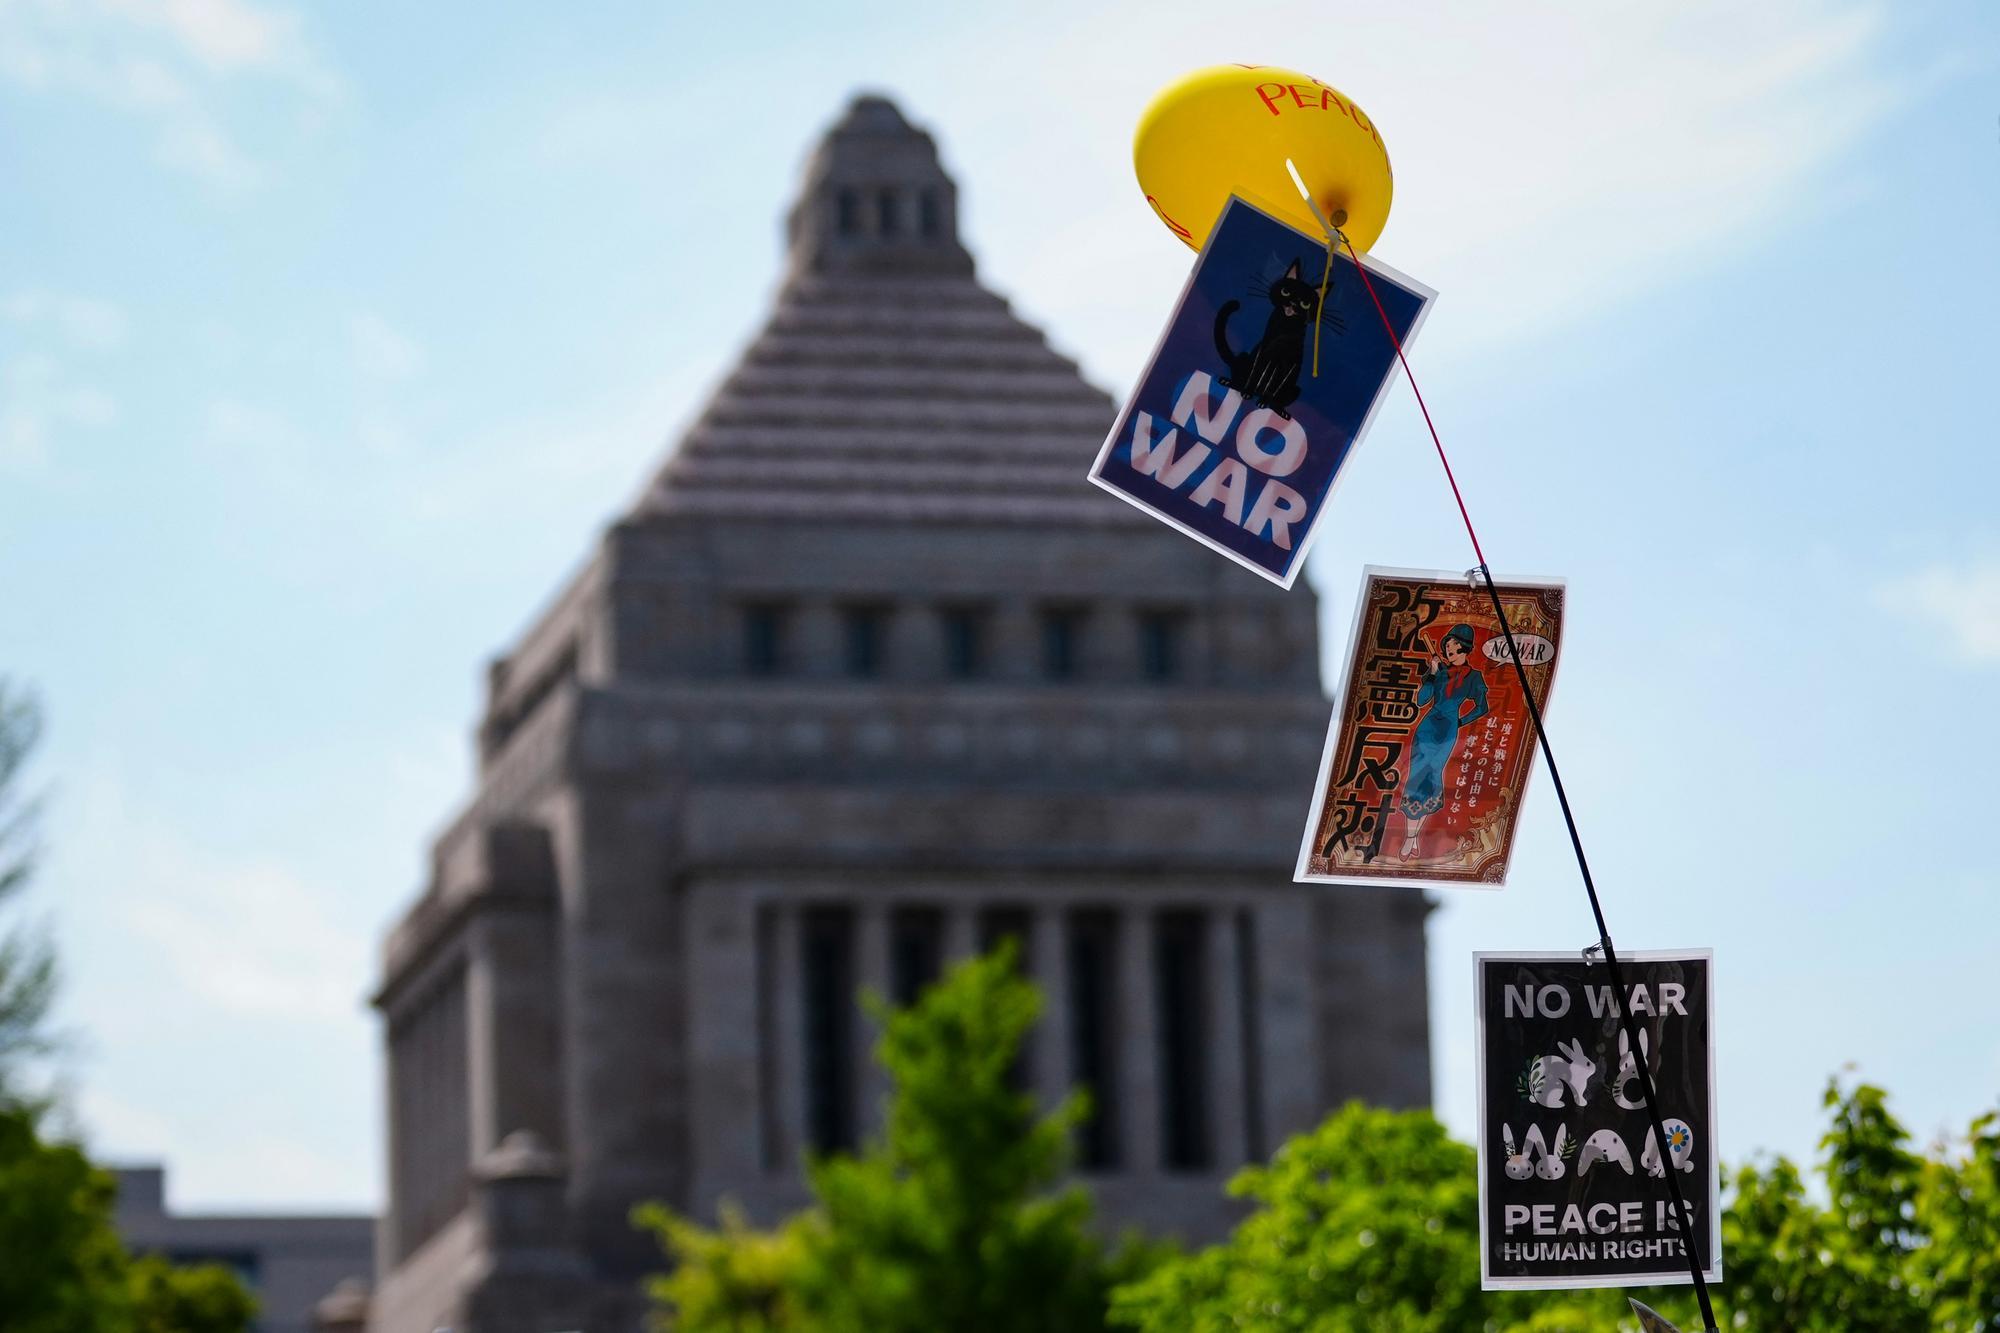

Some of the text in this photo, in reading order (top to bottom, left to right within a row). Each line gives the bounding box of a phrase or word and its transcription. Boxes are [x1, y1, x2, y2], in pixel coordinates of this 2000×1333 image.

[1170, 370, 1307, 477] NO
[1130, 410, 1307, 551] WAR
[1490, 641, 1546, 660] NO WAR
[1321, 585, 1445, 864] 改憲反対
[1468, 716, 1498, 808] 私たちの自由を
[1488, 710, 1516, 787] 二度と戦争に
[1447, 735, 1478, 825] 奪わせはしない
[1504, 982, 1689, 1019] NO WAR
[1504, 1201, 1644, 1235] PEACE
[1504, 1241, 1596, 1262] HUMAN
